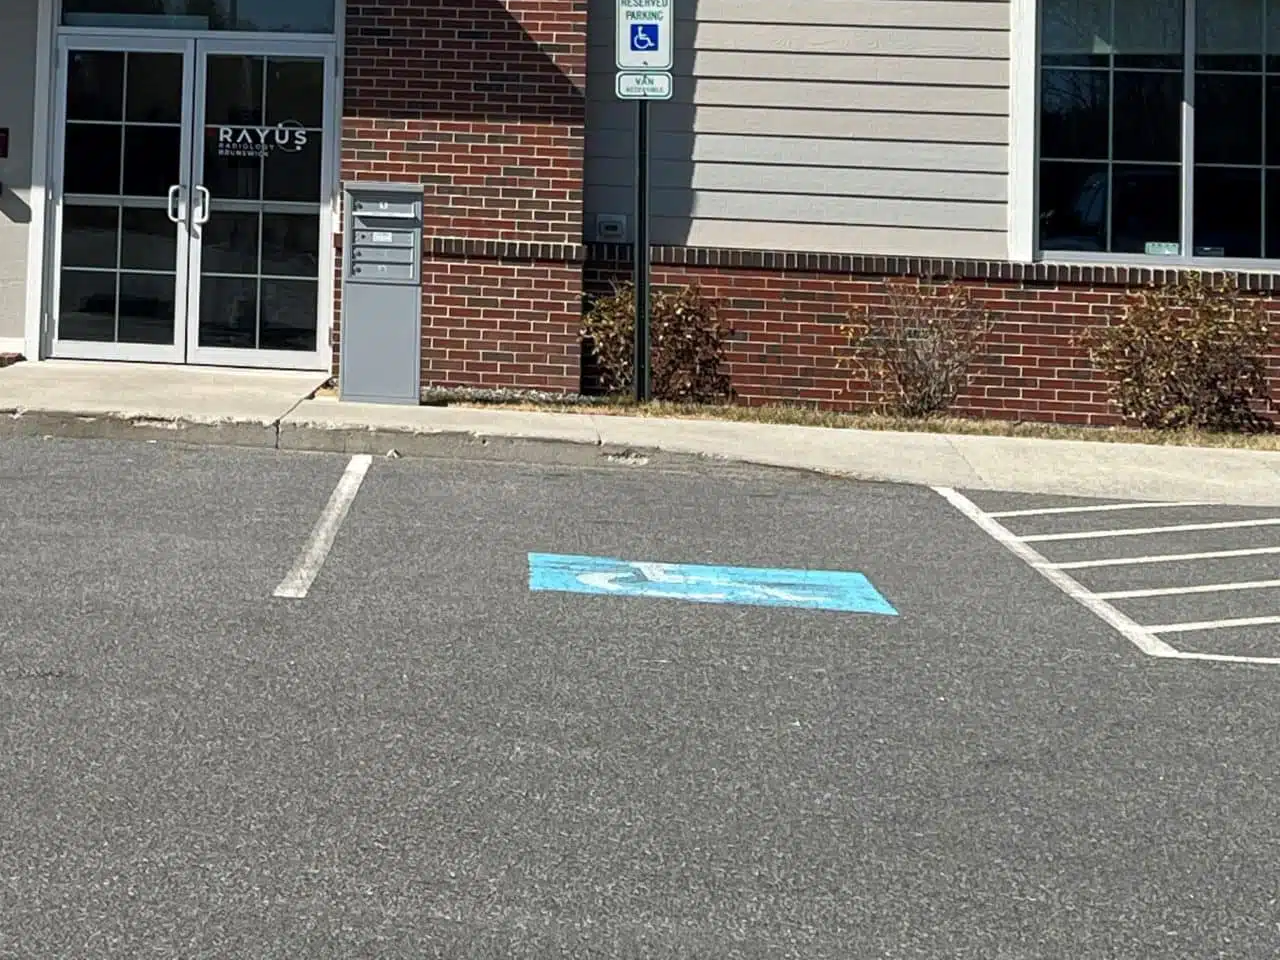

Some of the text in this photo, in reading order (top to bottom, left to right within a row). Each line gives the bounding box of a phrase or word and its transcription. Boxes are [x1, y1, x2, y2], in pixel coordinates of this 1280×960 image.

[625, 10, 664, 21] PARKING
[635, 77, 654, 86] VAN
[219, 127, 308, 145] RAYUS
[218, 142, 274, 150] RADIOLOGY
